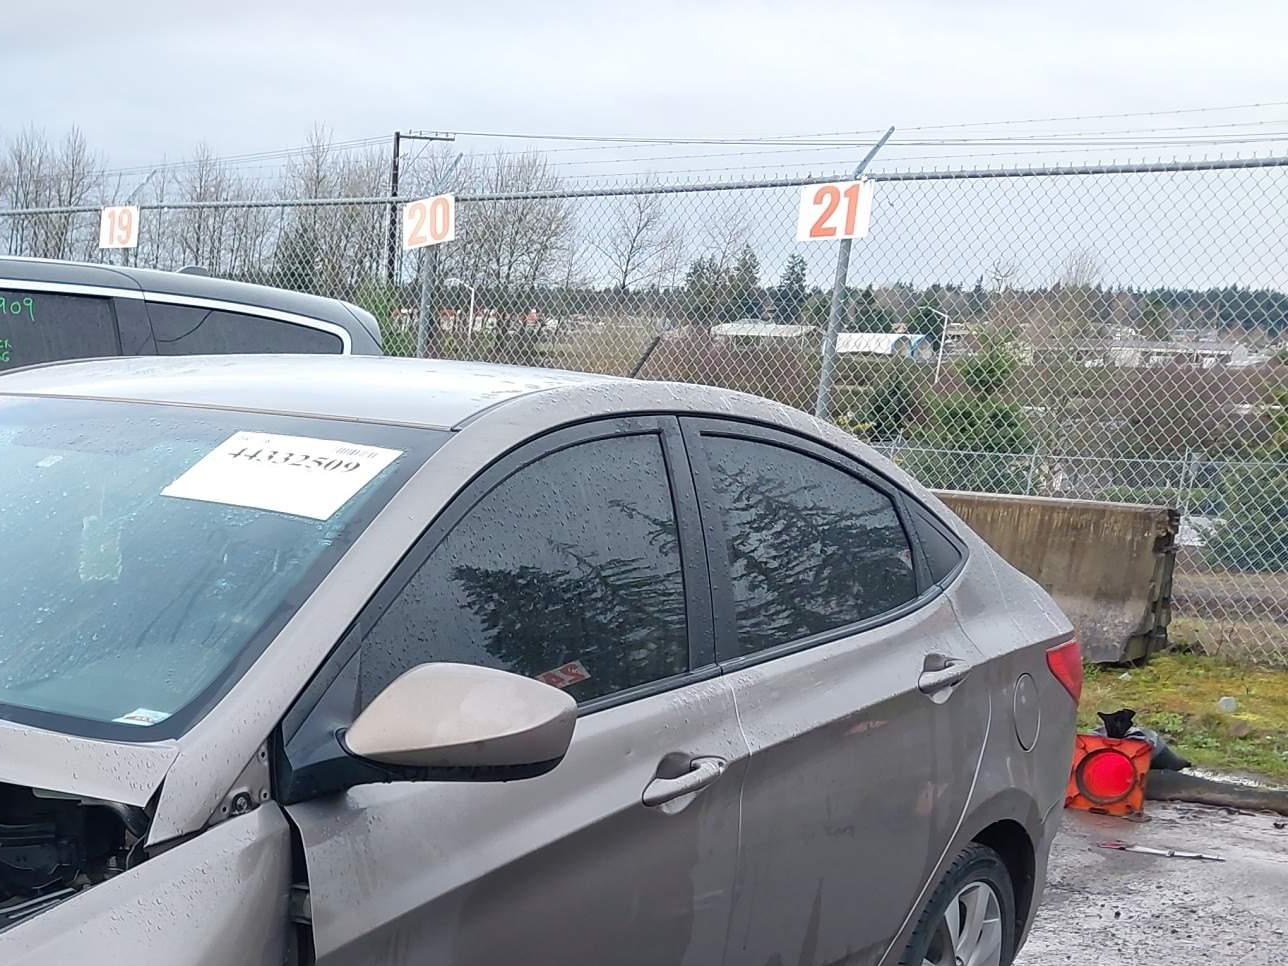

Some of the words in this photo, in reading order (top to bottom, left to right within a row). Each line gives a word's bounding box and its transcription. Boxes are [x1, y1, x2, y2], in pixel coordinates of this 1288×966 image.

[107, 208, 133, 246] 19
[407, 197, 450, 247] 20
[809, 183, 860, 238] 21
[227, 446, 362, 474] 44332509
